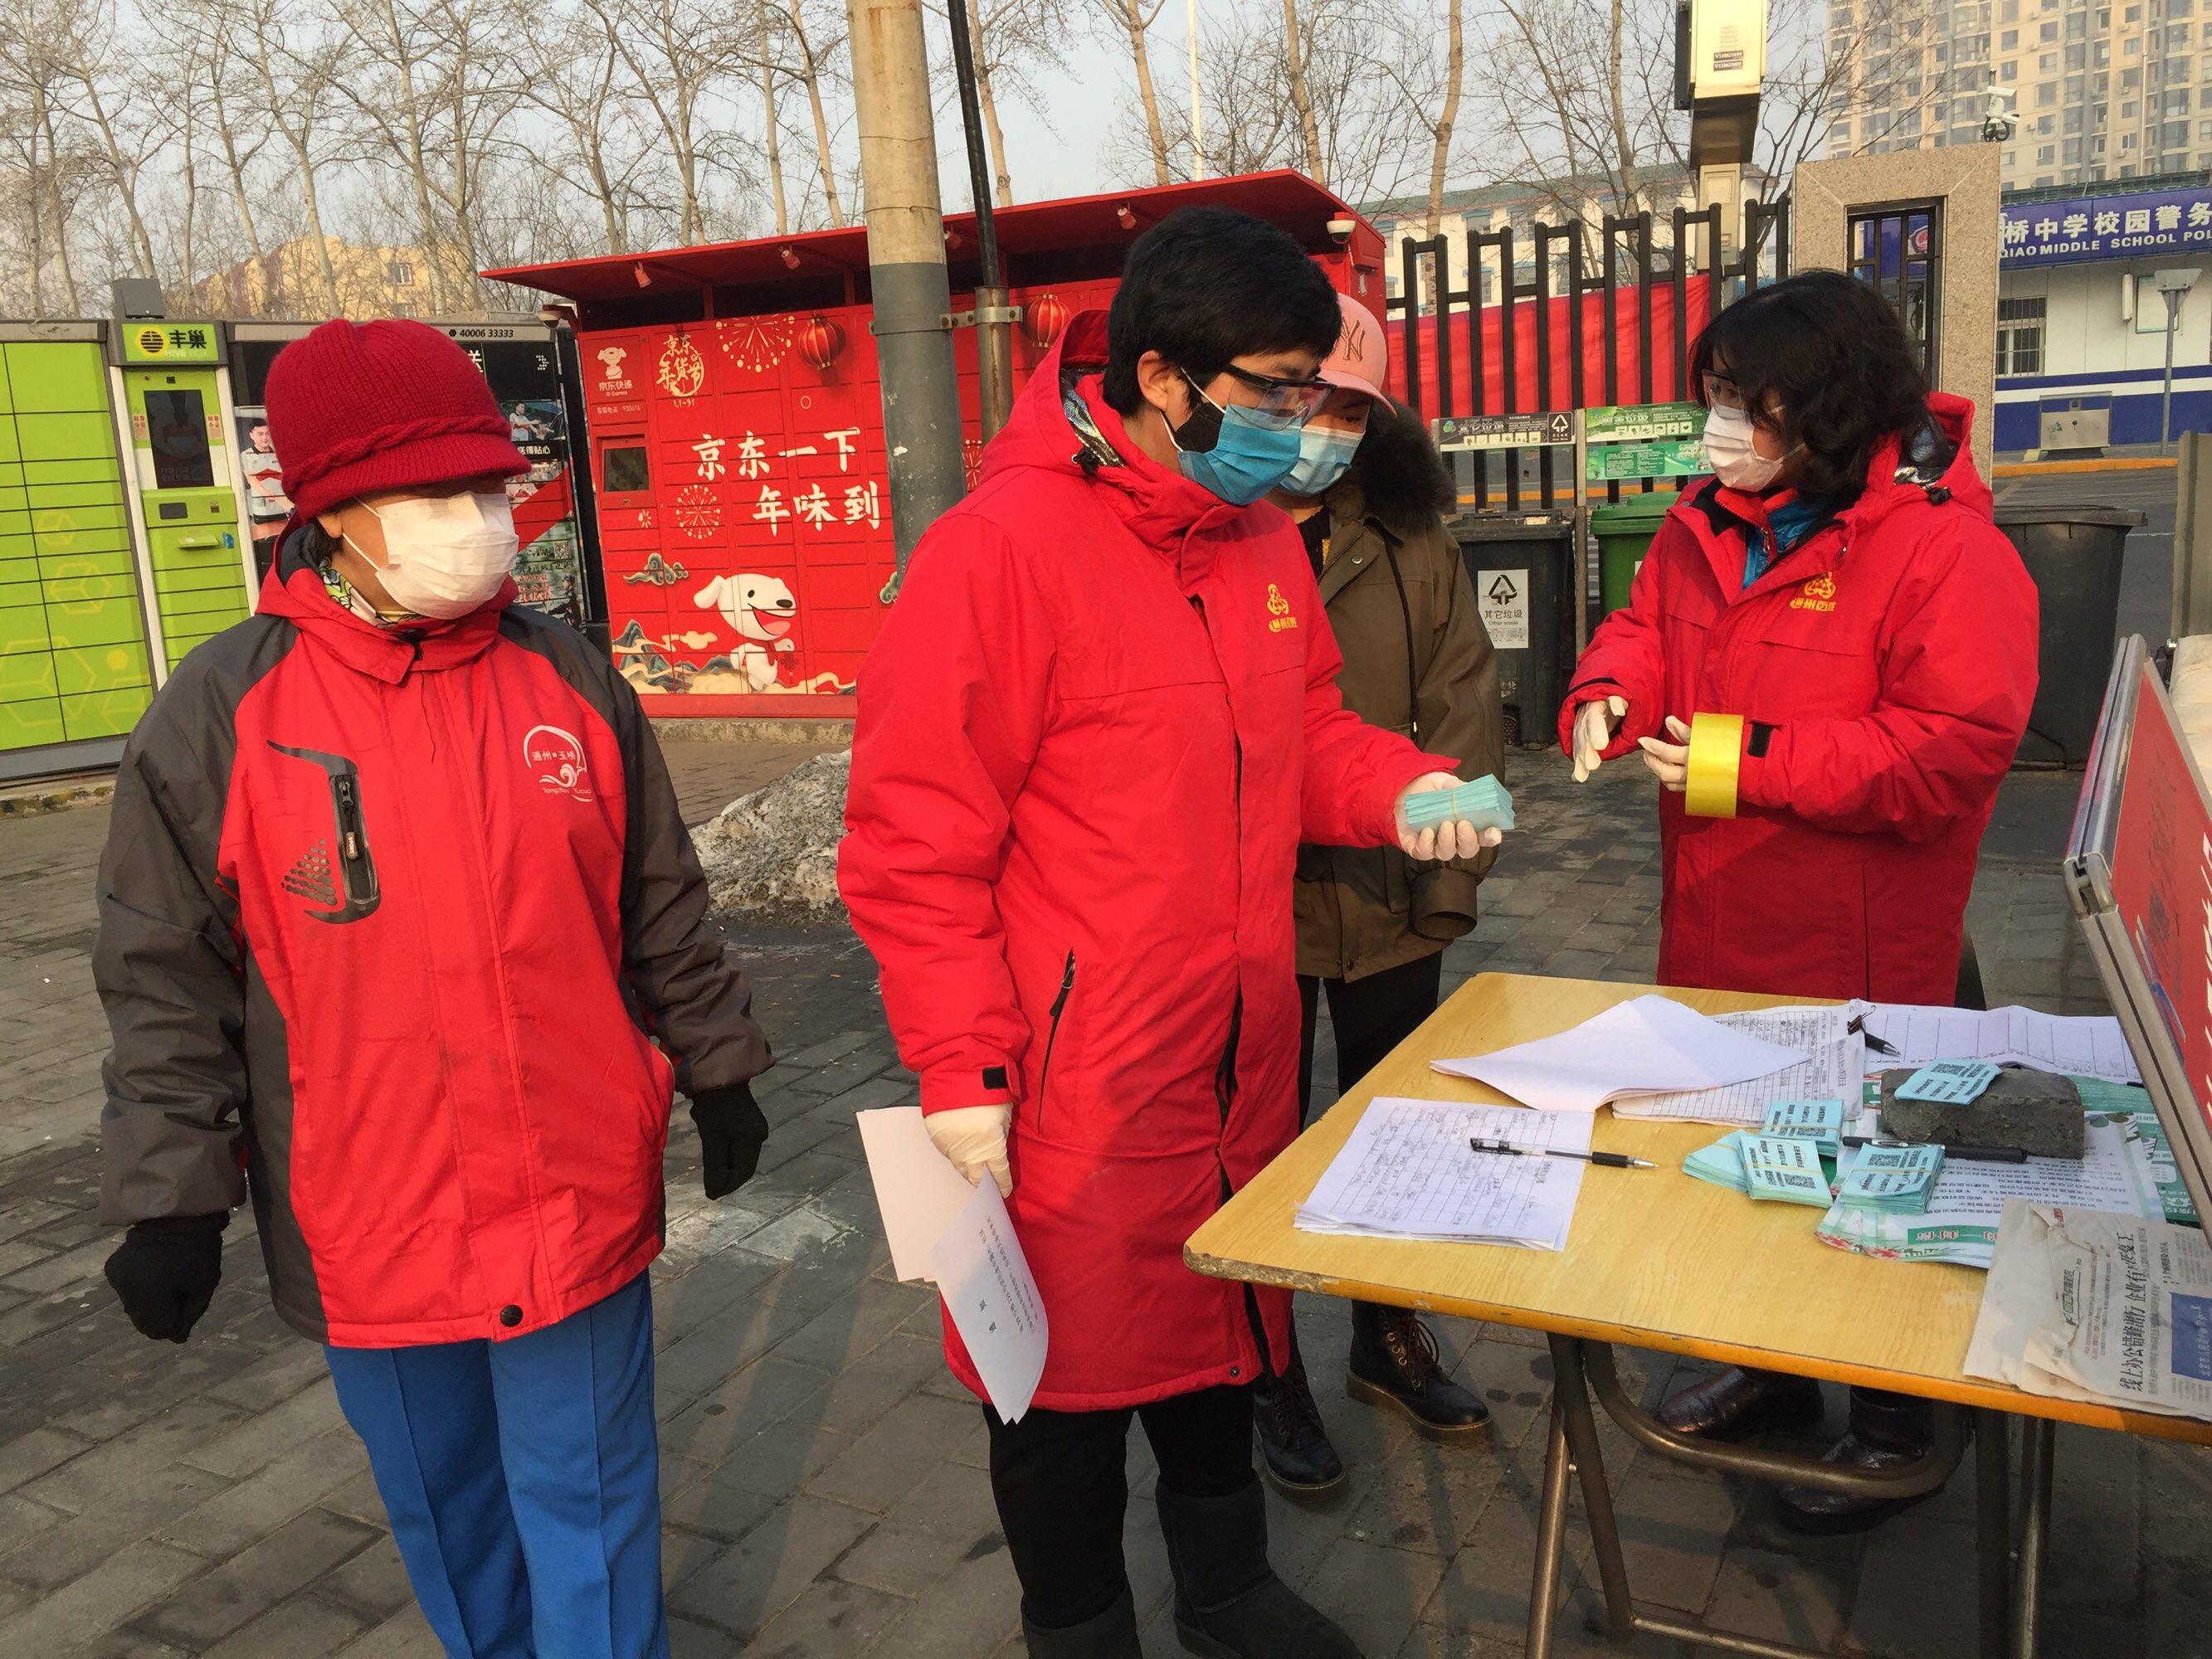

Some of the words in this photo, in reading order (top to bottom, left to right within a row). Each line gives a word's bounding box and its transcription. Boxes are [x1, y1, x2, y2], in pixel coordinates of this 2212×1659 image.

[2040, 240, 2100, 255] MIDDLE
[2111, 233, 2177, 249] SCHOOL
[168, 329, 207, 349] 丰巢
[459, 328, 486, 338] 40006
[488, 329, 514, 338] 33333
[598, 379, 633, 392] 京东快递
[691, 426, 861, 481] 京东一下
[753, 480, 880, 538] 年味到
[1484, 609, 1523, 620] 其它垃圾
